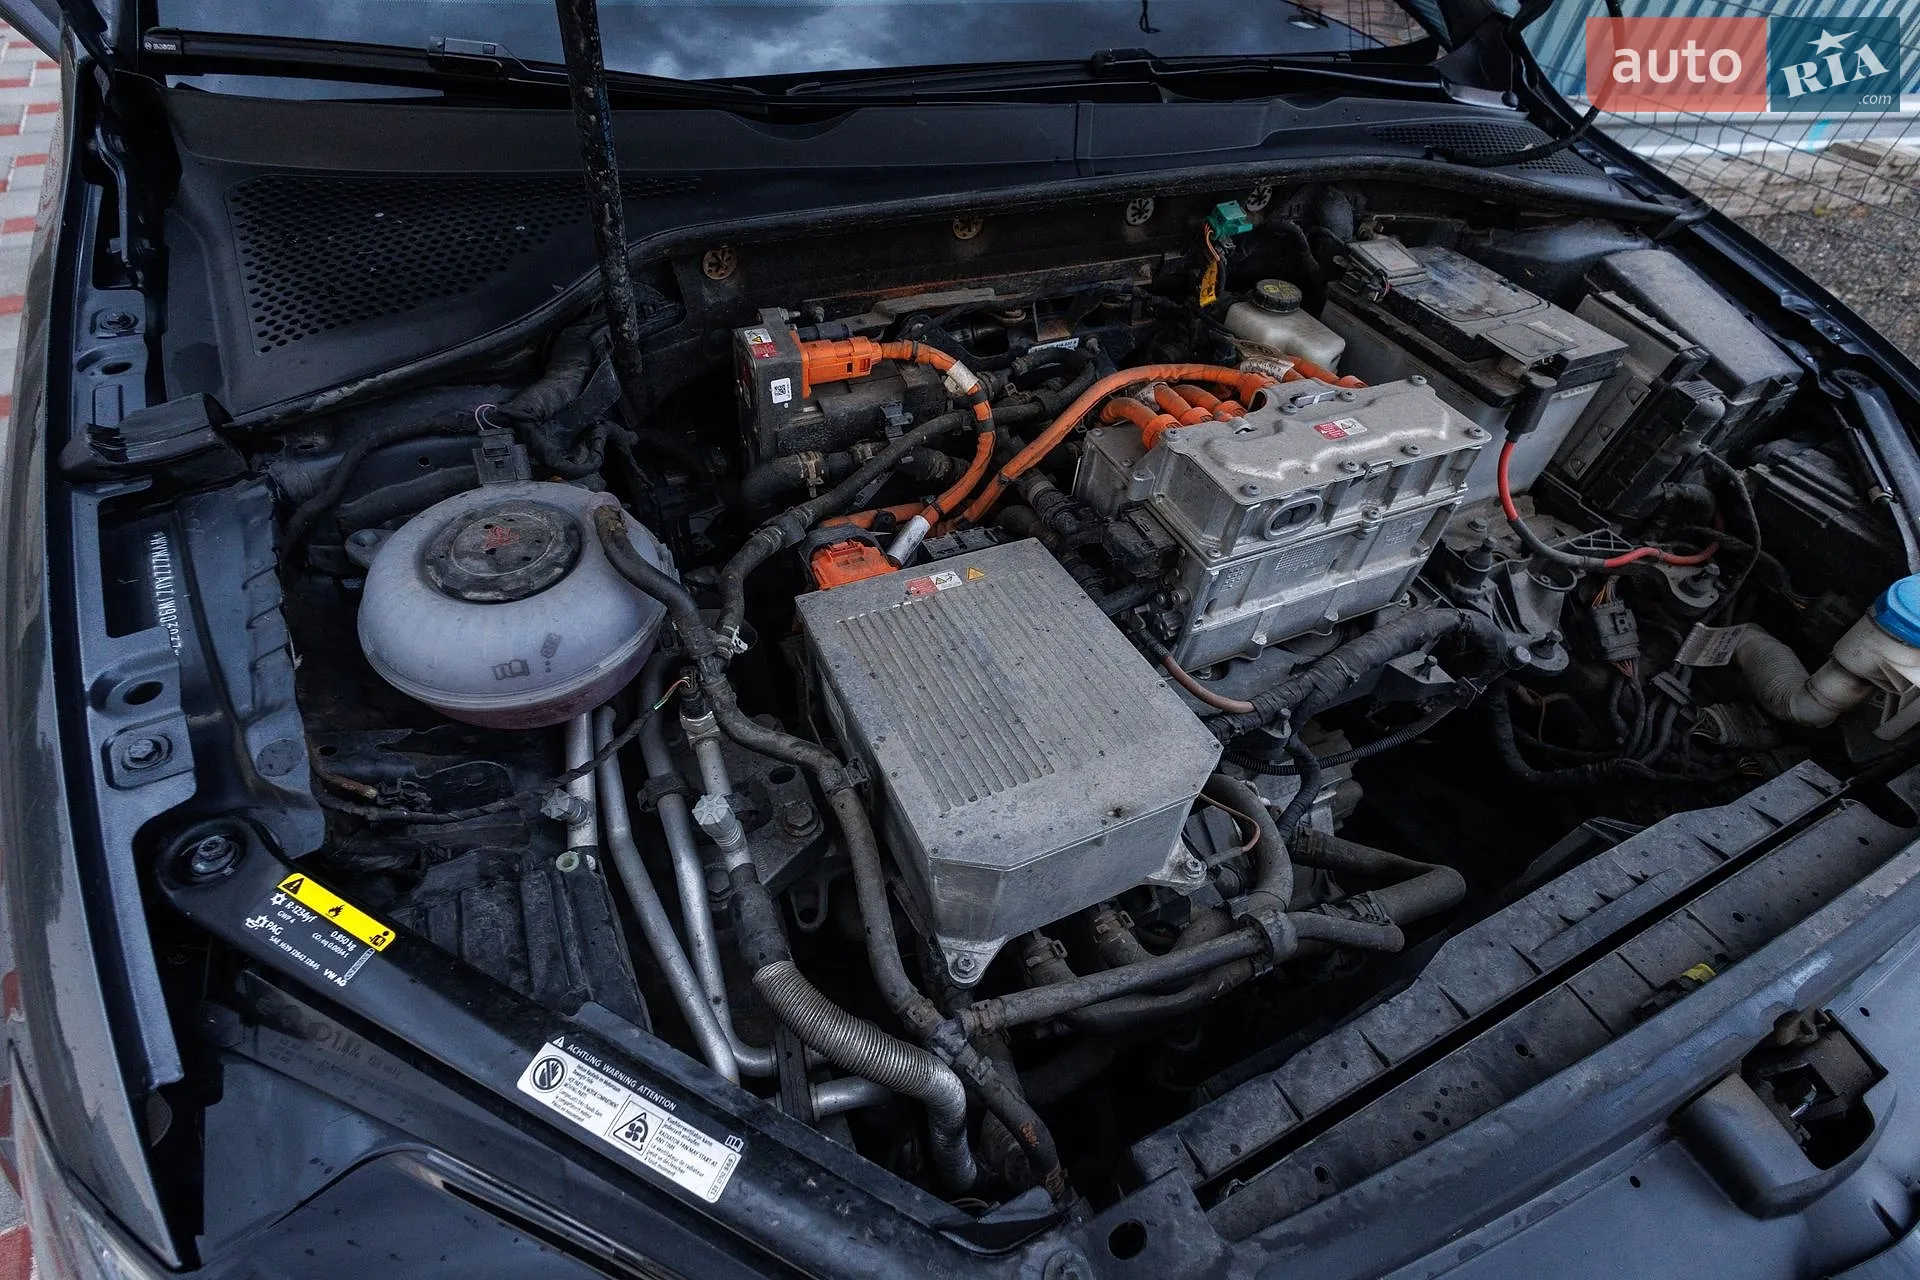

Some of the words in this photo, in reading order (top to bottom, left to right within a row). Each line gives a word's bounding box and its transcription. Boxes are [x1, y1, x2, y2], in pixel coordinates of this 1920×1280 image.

[265, 921, 283, 935] PAG
[285, 901, 317, 922] R-1234yf
[346, 940, 356, 951] kg
[323, 969, 336, 980] VW
[334, 977, 347, 986] AG
[567, 1044, 602, 1067] ACHTUNG
[603, 1064, 637, 1087] WARNING
[638, 1086, 677, 1111] ATTENTION
[655, 1136, 665, 1144] ANY
[658, 1130, 680, 1145] RADIATOR
[679, 1142, 689, 1150] FAN
[688, 1147, 698, 1156] MAY
[698, 1153, 712, 1163] START
